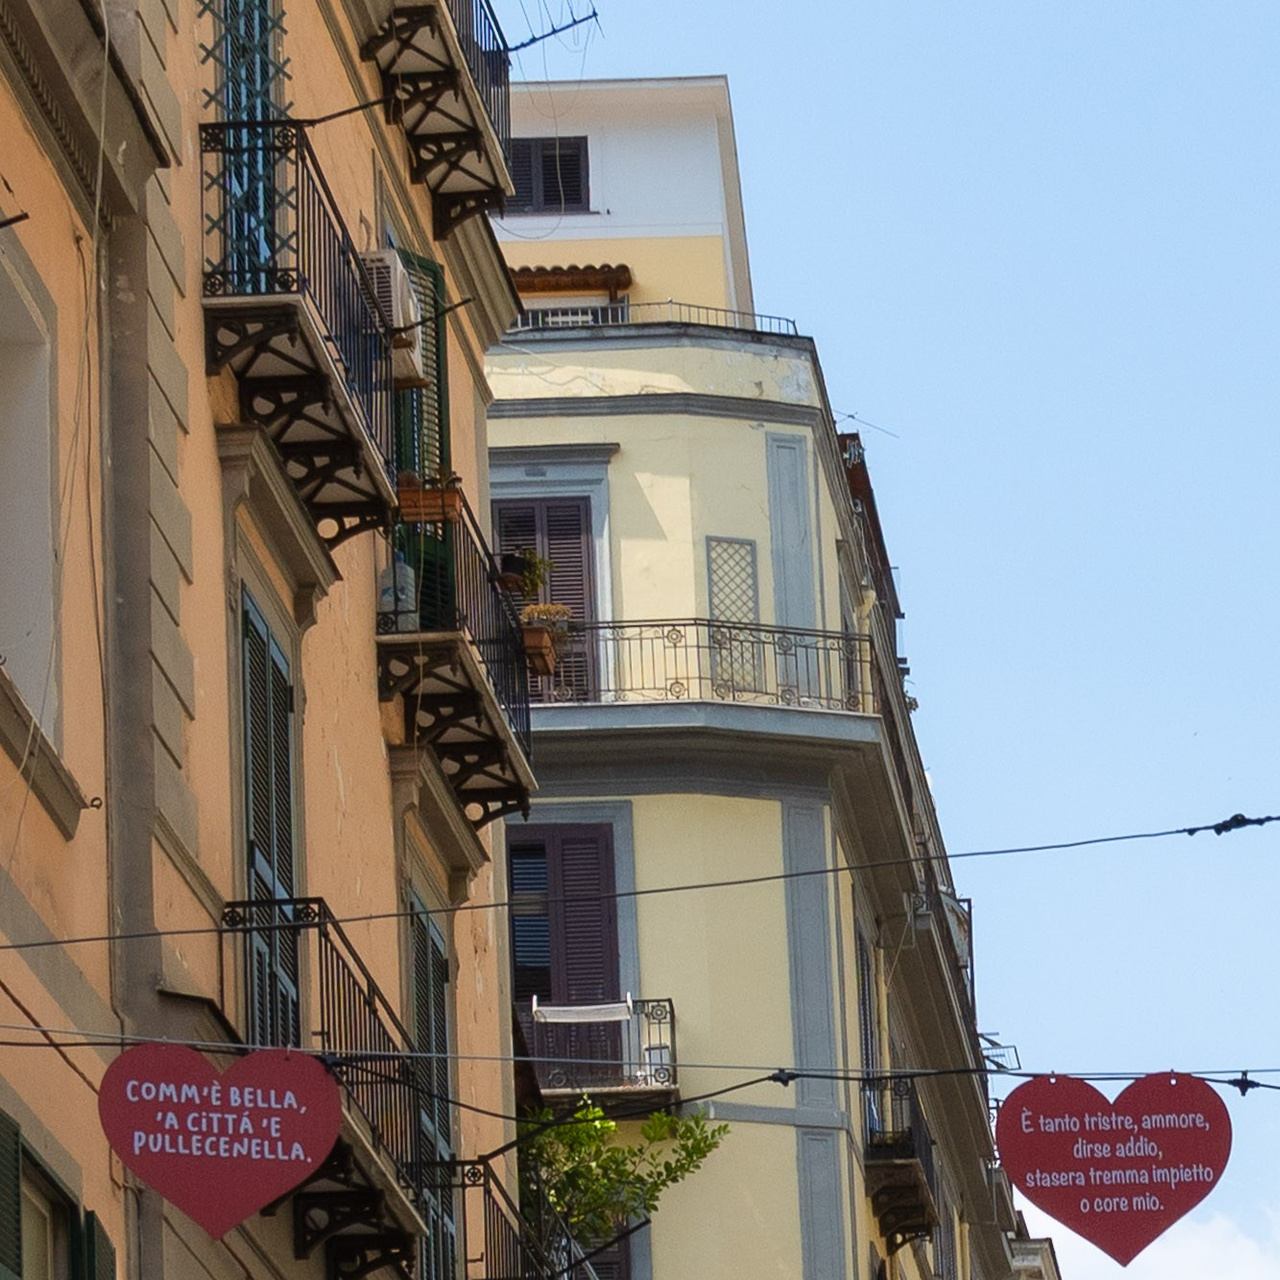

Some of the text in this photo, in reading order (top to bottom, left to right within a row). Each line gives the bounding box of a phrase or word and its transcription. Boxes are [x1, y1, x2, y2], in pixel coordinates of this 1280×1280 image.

[1022, 1108, 1034, 1133] È
[1039, 1116, 1080, 1133] tanto
[1142, 1112, 1210, 1131] ammore,
[1074, 1136, 1163, 1159] dirse addio,
[1026, 1165, 1213, 1189] stasera tremma impietto
[1080, 1193, 1163, 1213] o core mio.
